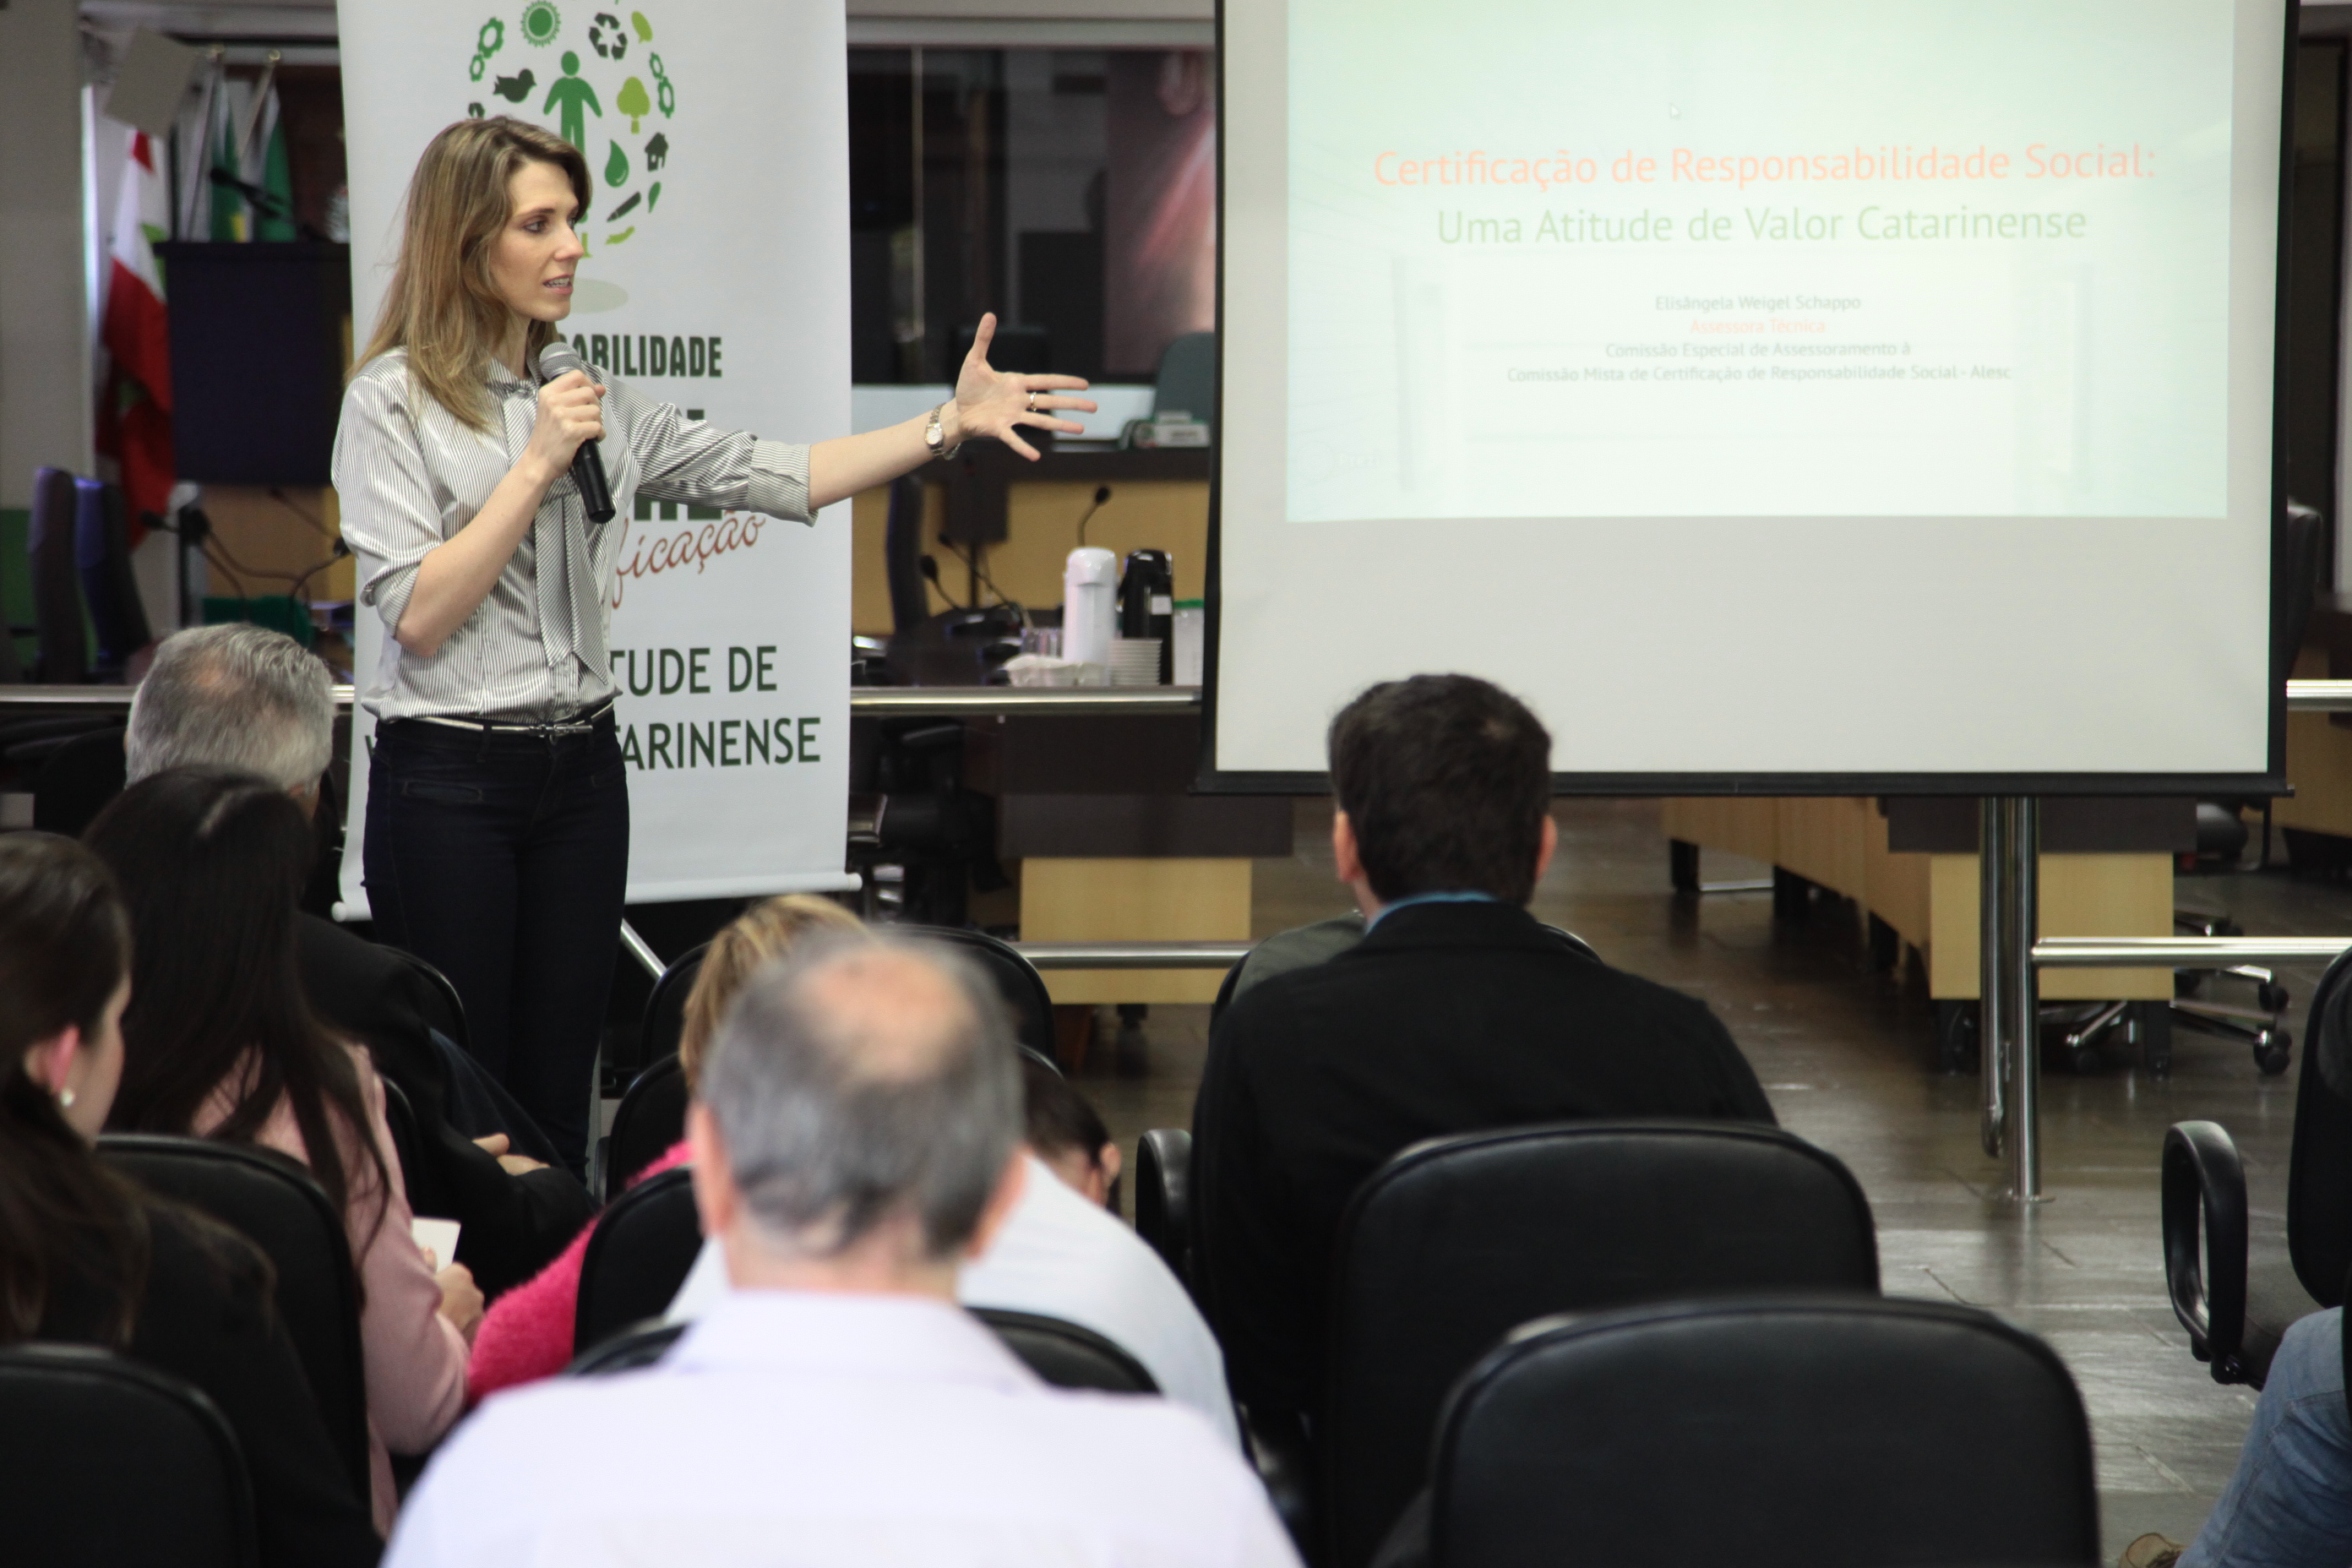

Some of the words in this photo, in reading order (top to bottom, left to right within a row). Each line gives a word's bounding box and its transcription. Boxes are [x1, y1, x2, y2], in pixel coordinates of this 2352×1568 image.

[1374, 150, 1597, 193] Certificação
[1611, 149, 1657, 183] de
[1671, 145, 2010, 190] Responsabilidade
[2024, 143, 2155, 180] Social:
[1438, 210, 1522, 244] Uma
[1534, 209, 1673, 243] Atitude
[1687, 208, 1733, 242] de
[1744, 206, 1843, 241] Valor
[1858, 205, 2087, 241] Catarinense
[1655, 296, 1733, 313] Elisângela
[1738, 295, 1789, 313] Weigel
[1795, 295, 1861, 312] Schappo
[1690, 319, 1764, 334] Assessora
[1769, 318, 1826, 334] Técnica
[558, 333, 723, 378] ABILIDADE
[1605, 343, 1678, 357] Comissão
[1683, 342, 1745, 360] Especial
[1750, 342, 1768, 357] de
[1772, 342, 1897, 357] Assessoramento
[1507, 368, 1579, 382] Comissão
[1583, 367, 1625, 381] Mista
[1630, 367, 1647, 381] de
[1653, 366, 1742, 383] Certificação
[1747, 366, 1766, 380] de
[1771, 365, 1906, 382] Responsabilidade
[1911, 364, 1957, 378] Social
[1970, 364, 2012, 378] Alesc
[728, 645, 777, 692] DE
[616, 717, 820, 770] ARINENSE
